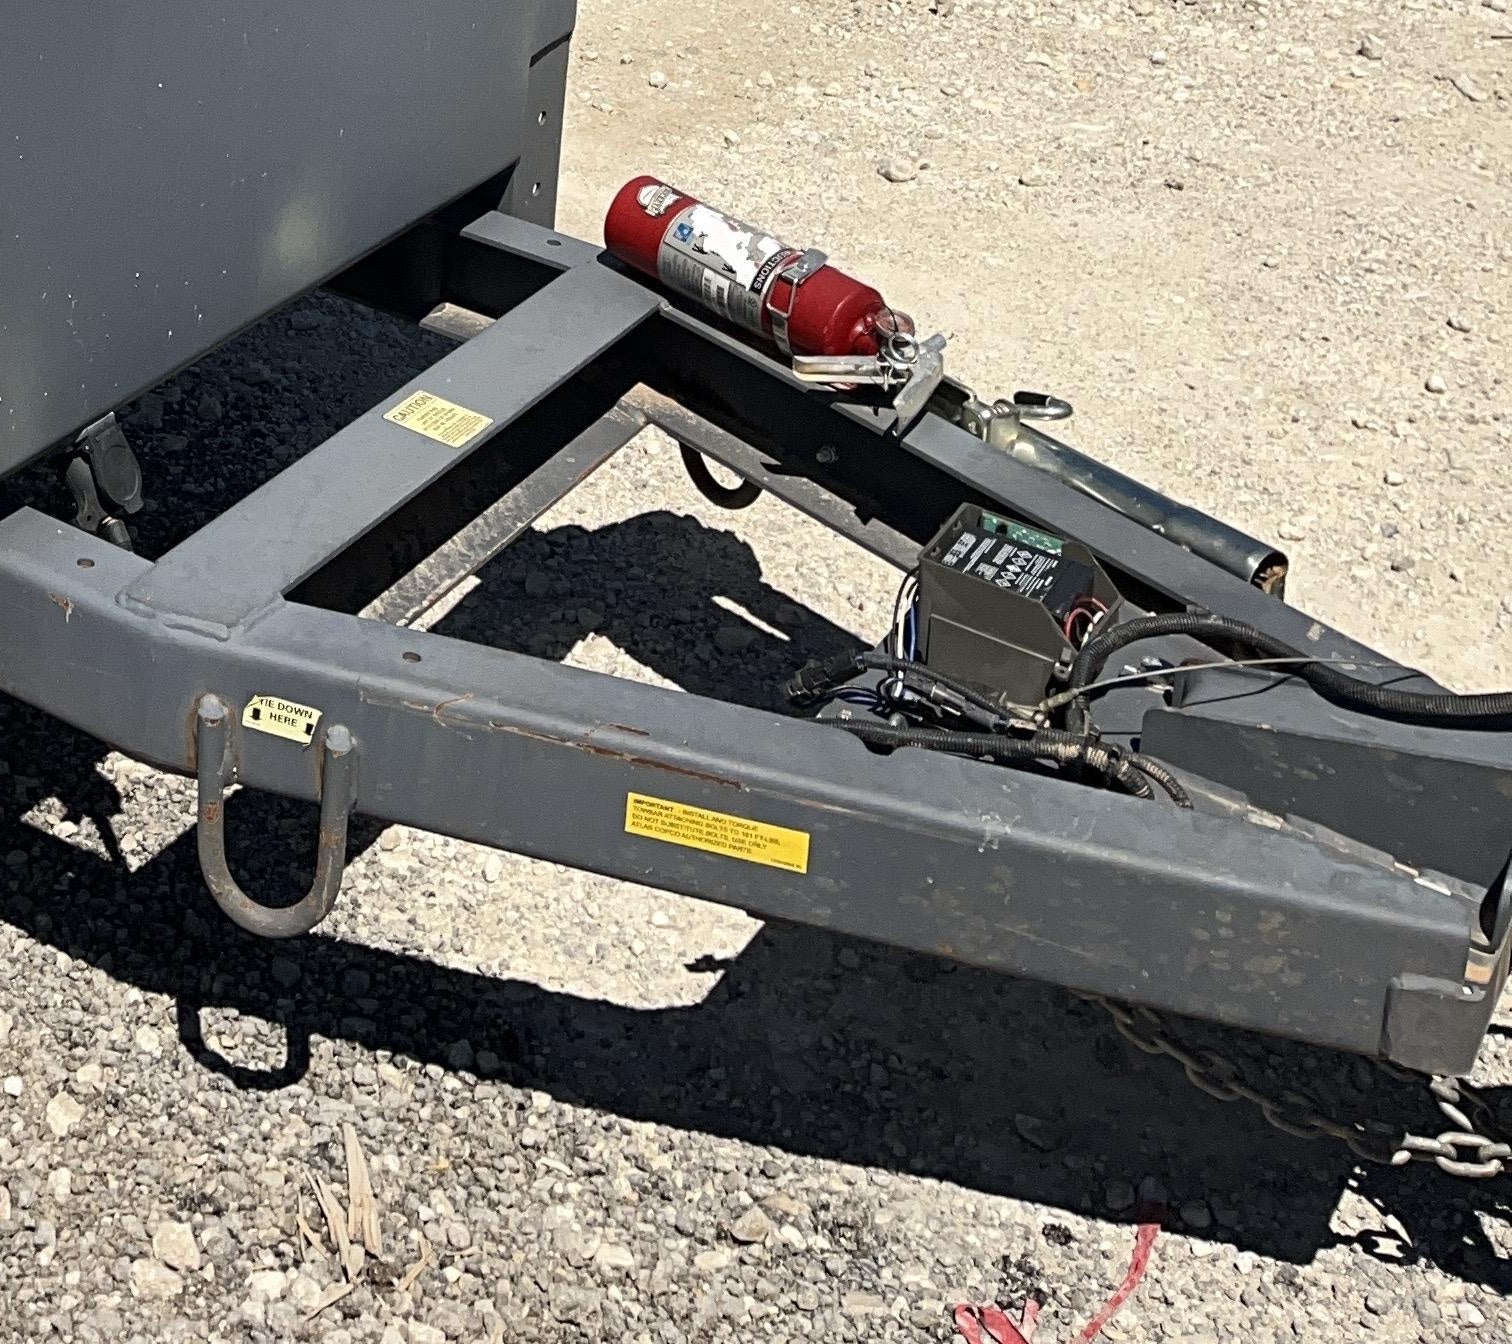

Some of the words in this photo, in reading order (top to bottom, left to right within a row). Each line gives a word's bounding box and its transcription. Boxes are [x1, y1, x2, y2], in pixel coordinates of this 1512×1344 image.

[392, 394, 433, 423] CAUTION
[258, 698, 275, 709] TIE
[277, 702, 313, 719] DOWN
[269, 711, 298, 728] HERE
[632, 812, 643, 820] DO
[644, 816, 659, 824] NOT
[633, 798, 674, 813] IMPORTANT
[711, 816, 727, 825] AND
[631, 821, 654, 831] ATLAS
[654, 826, 681, 837] COPCO
[728, 843, 752, 855] PARTS
